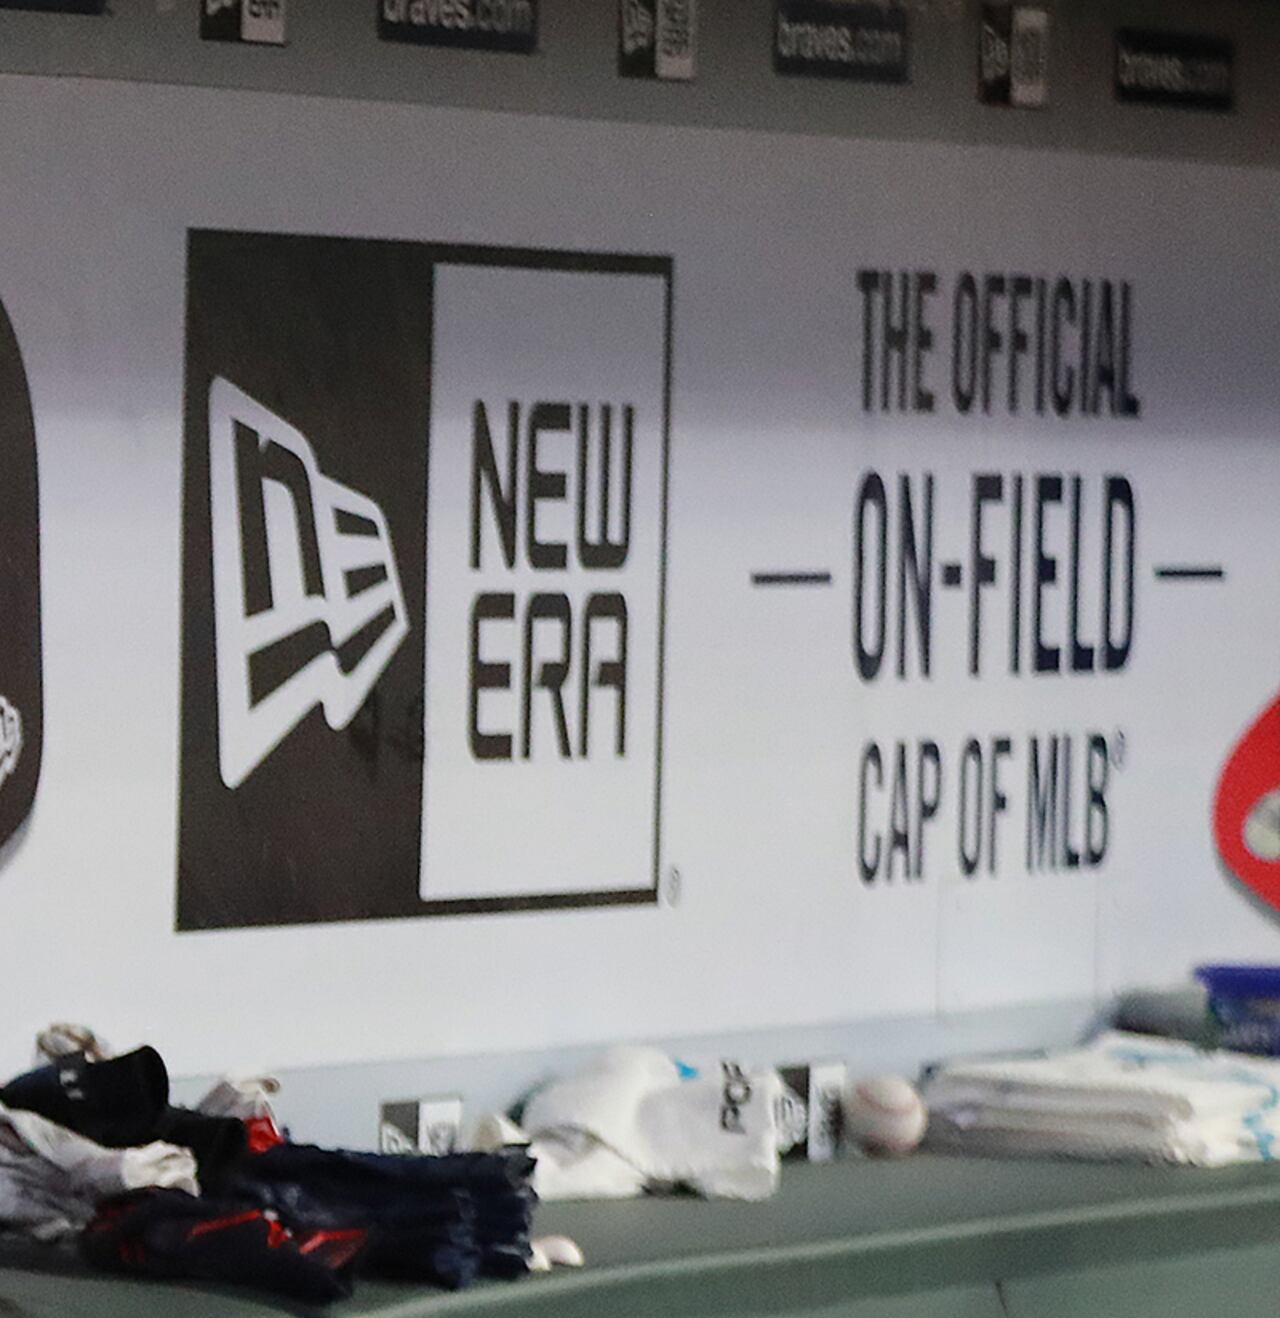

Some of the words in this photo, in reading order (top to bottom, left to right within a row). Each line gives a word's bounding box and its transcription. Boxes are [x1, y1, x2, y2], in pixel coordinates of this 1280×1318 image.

[855, 270, 936, 413] THE
[951, 272, 1141, 418] OFFICIAL
[470, 398, 634, 572] NEW
[851, 467, 1137, 682] ON-FIELD
[468, 590, 628, 761] ERA
[857, 741, 941, 885] CAP
[959, 738, 1012, 876] OF
